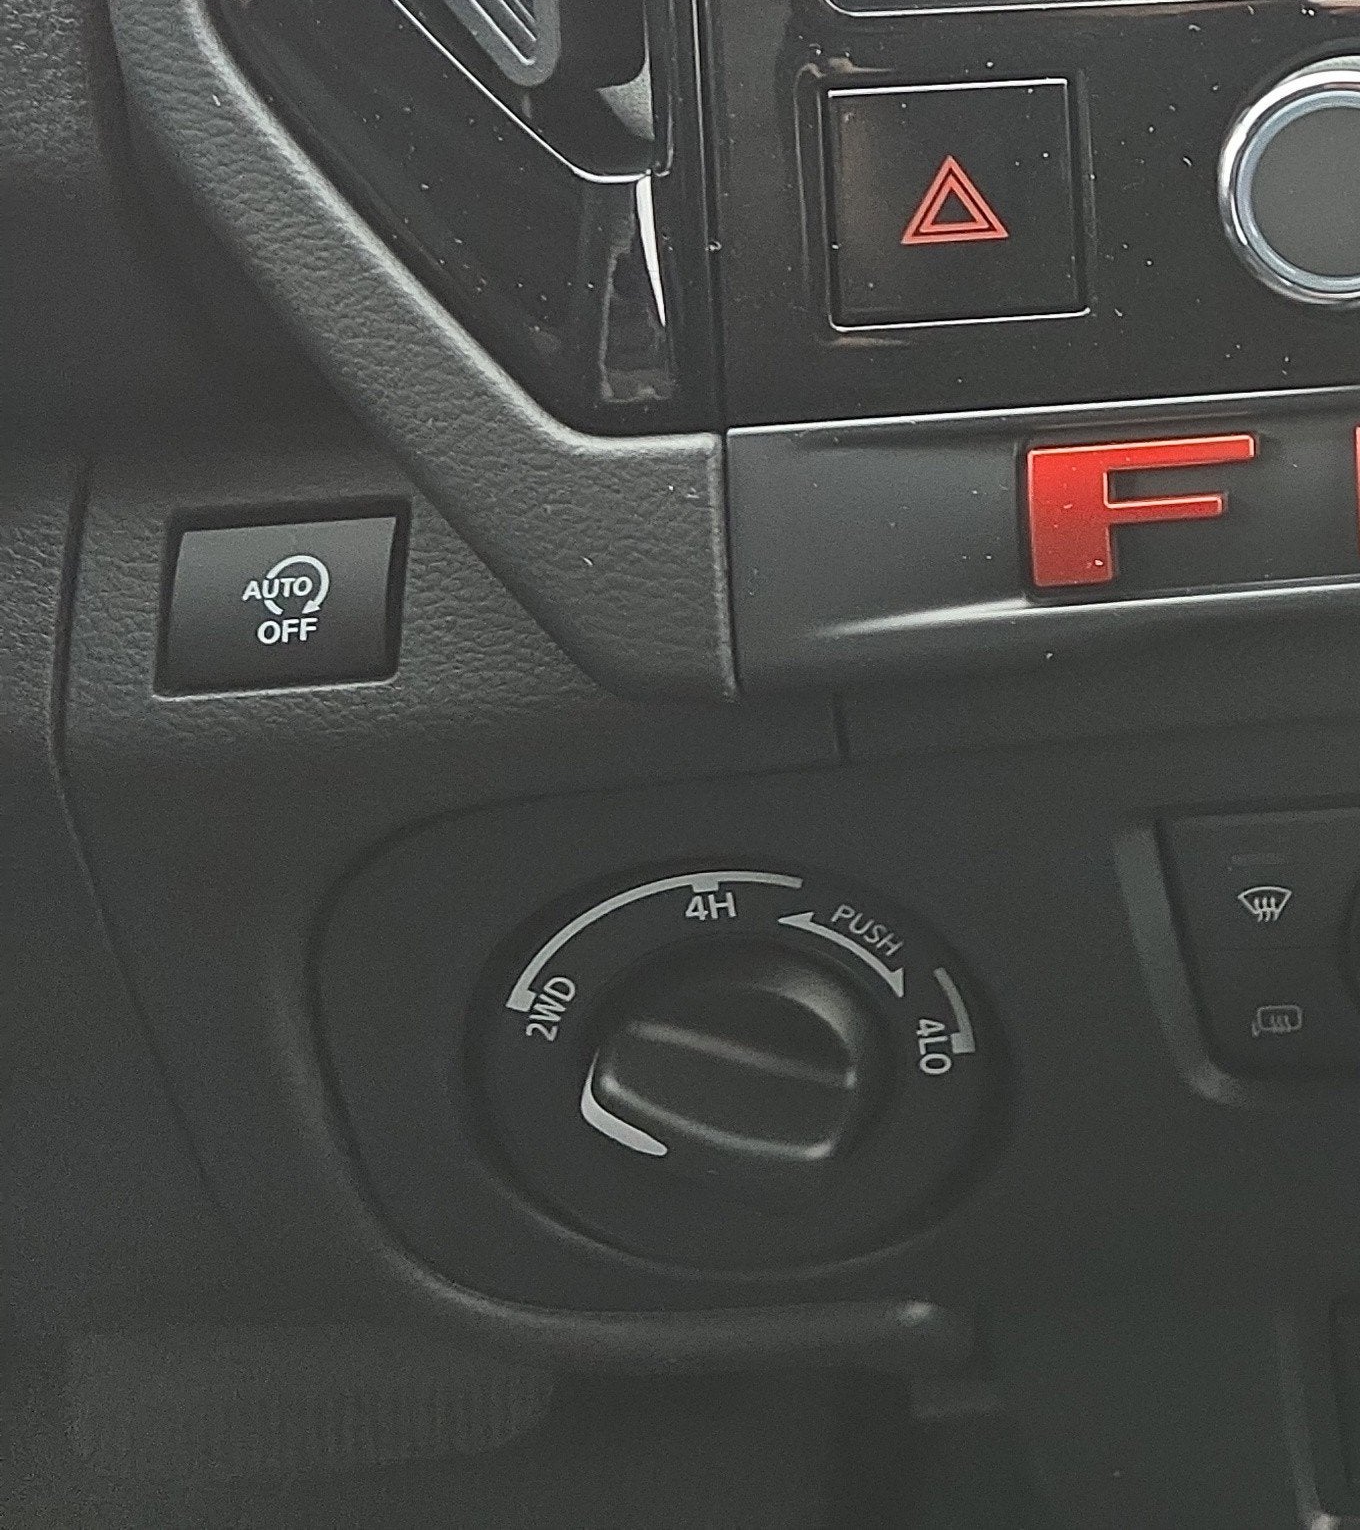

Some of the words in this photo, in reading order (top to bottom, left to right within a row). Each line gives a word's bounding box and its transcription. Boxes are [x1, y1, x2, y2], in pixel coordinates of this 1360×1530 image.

[242, 576, 313, 601] AUTO
[257, 618, 316, 645] OFF
[684, 892, 737, 921] 4H
[830, 902, 903, 958] PUSH
[524, 974, 577, 1043] 2WD
[915, 1015, 952, 1075] 4LO
